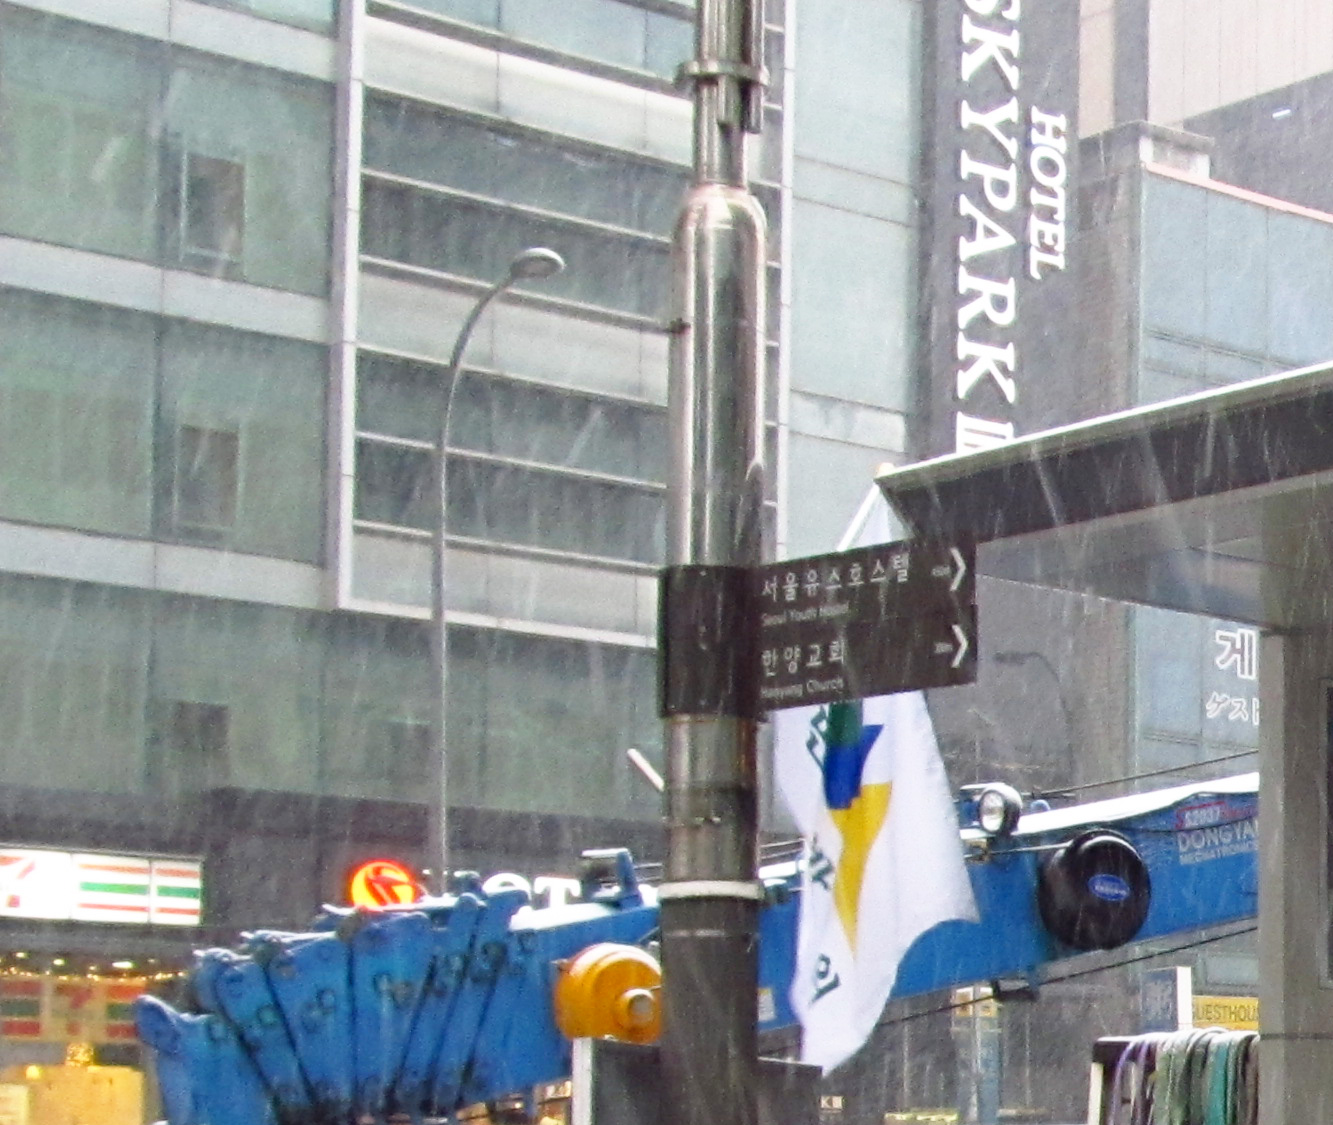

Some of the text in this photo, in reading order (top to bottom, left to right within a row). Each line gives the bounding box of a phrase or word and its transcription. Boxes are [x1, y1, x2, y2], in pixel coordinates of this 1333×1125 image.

[1029, 105, 1067, 280] HOTEL
[761, 552, 910, 602] 서울유스호스텔
[761, 639, 845, 677] 한양교회
